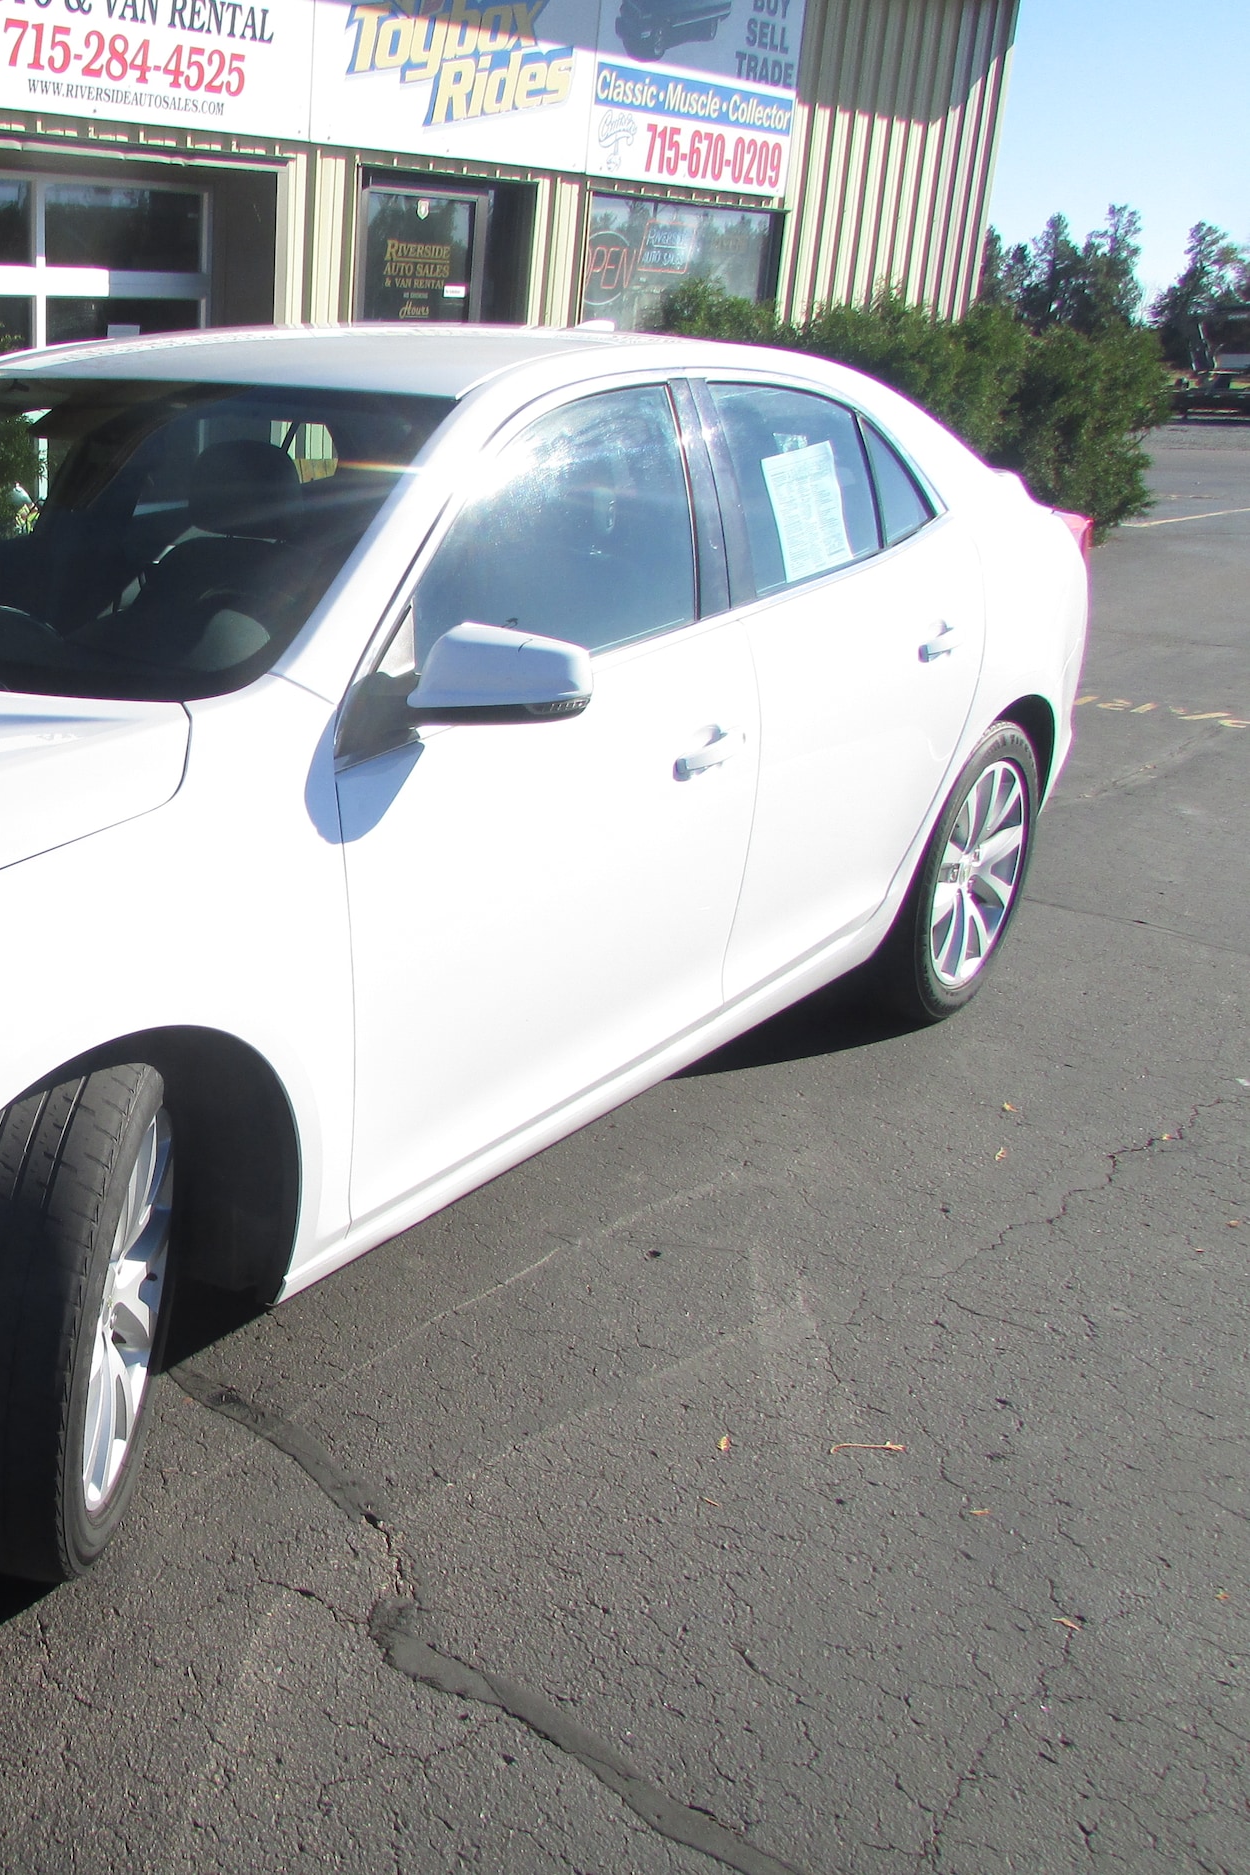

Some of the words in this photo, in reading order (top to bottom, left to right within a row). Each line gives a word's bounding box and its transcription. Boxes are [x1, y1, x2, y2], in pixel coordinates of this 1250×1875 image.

[106, 0, 159, 25] VAN
[167, 0, 275, 44] RENTAL
[347, 0, 544, 83] Toybox
[745, 18, 789, 55] SELL
[3, 17, 246, 97] 715-284-4525
[735, 51, 794, 90] TRADE
[27, 78, 225, 116] WWW.RIVERSIDEAUTOSALES.COM
[426, 49, 575, 125] Rides
[596, 68, 657, 109] Classic
[664, 82, 720, 119] Muscle
[728, 93, 792, 131] Collector
[644, 122, 783, 189] 715-670-0209
[383, 262, 414, 276] AUTO
[415, 263, 450, 278] SALES
[395, 277, 412, 289] VAN
[586, 245, 637, 290] PEN
